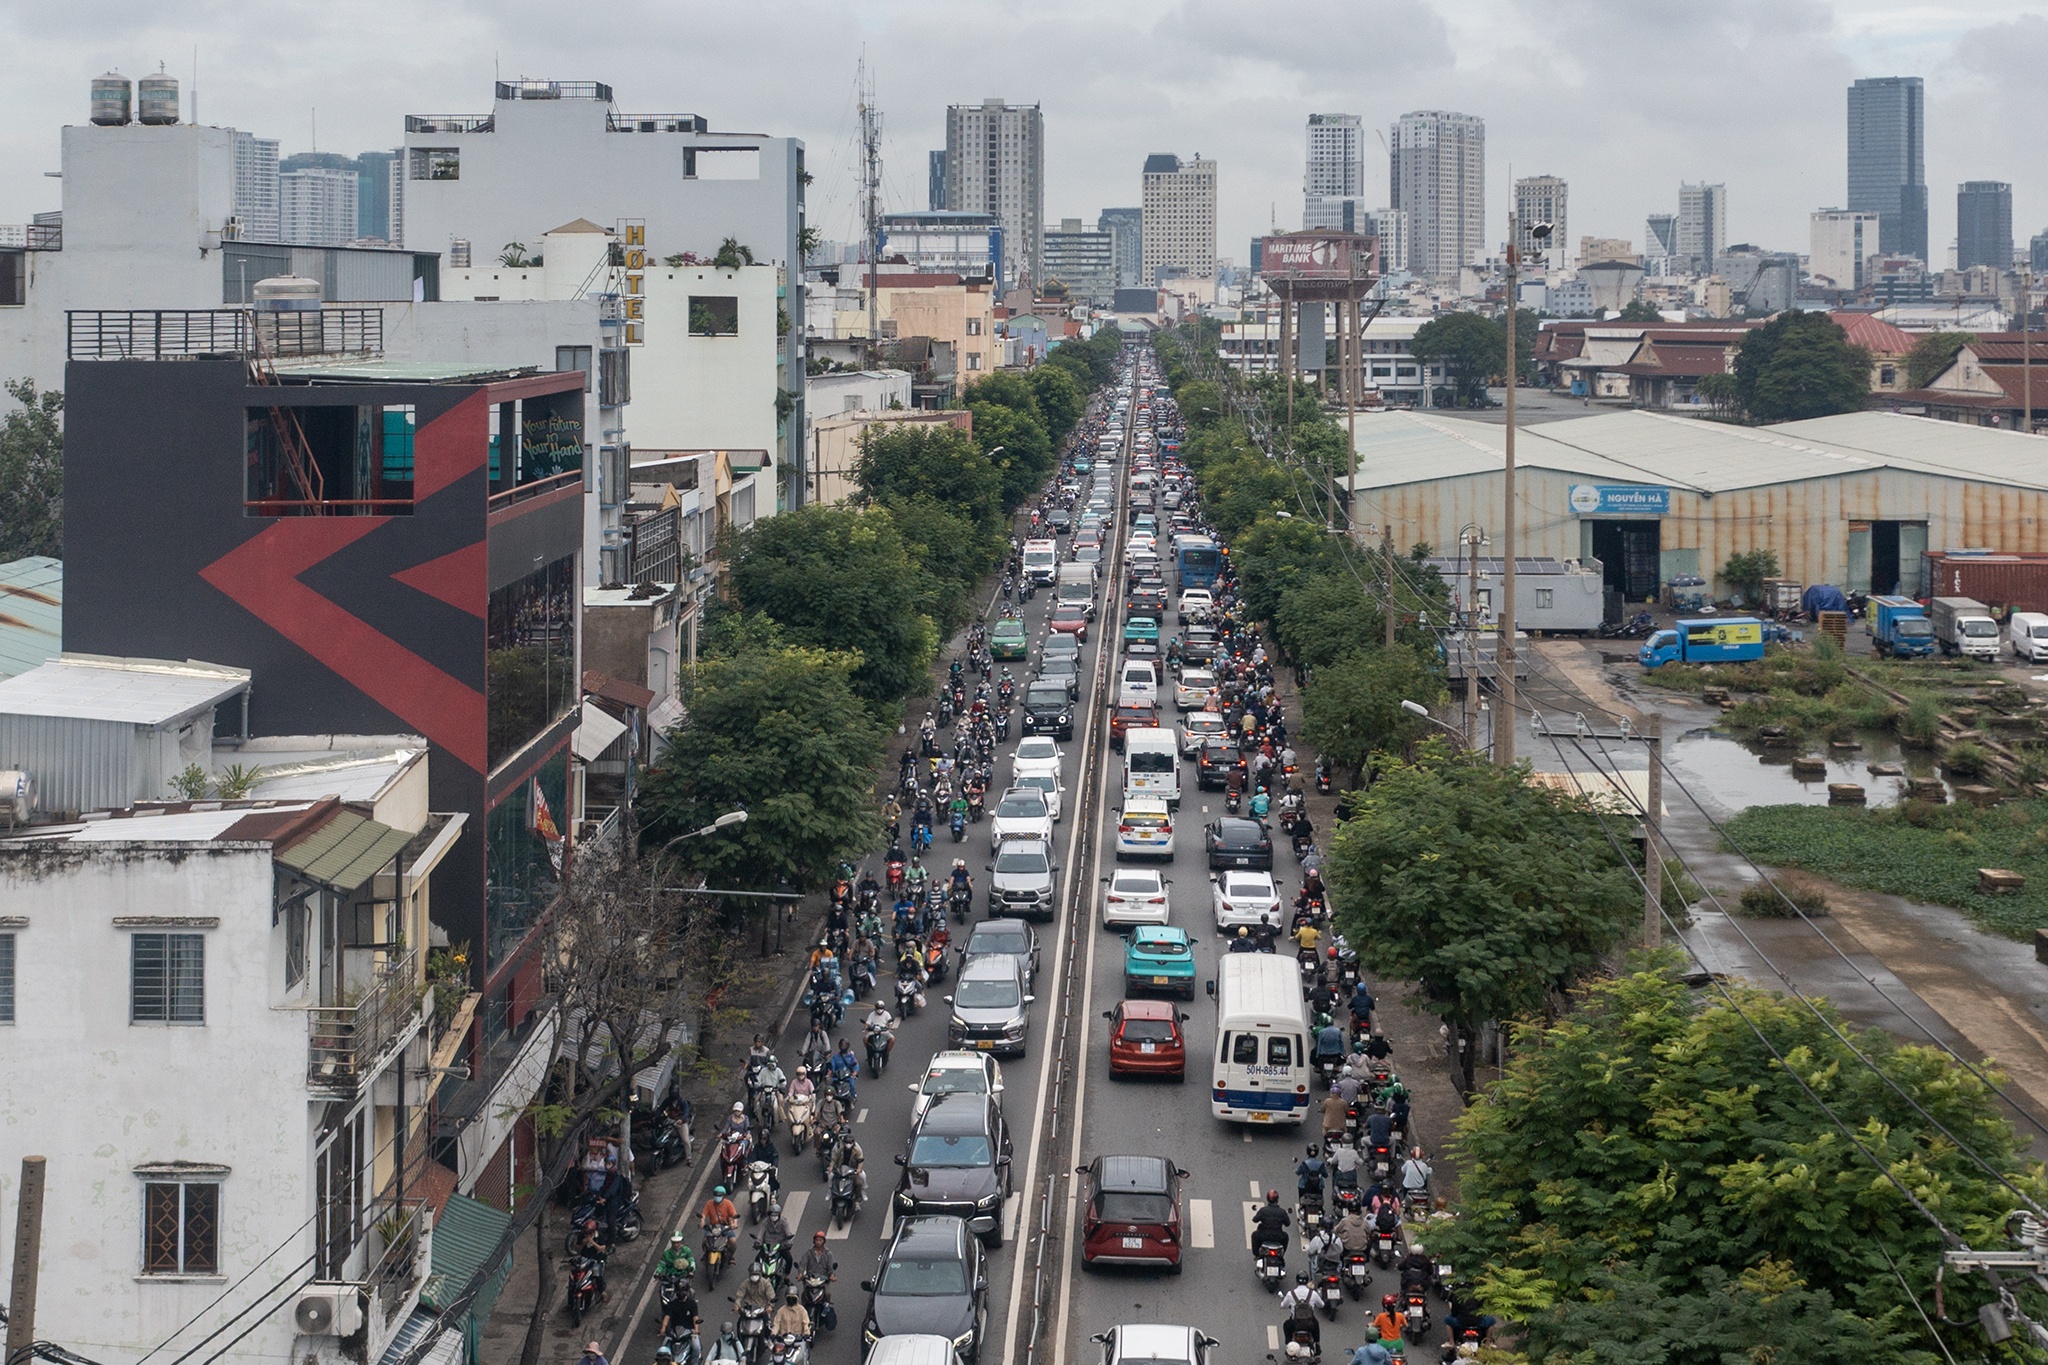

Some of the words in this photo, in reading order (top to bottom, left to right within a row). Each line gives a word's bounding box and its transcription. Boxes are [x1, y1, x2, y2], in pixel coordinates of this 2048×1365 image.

[1268, 243, 1312, 254] MARITIME
[1282, 253, 1311, 263] BANK
[625, 225, 645, 343] HOTEL
[523, 419, 547, 436] Your
[549, 415, 582, 433] Future
[523, 438, 549, 460] Your
[549, 434, 583, 462] Hand
[1648, 493, 1662, 503] HÀ
[1246, 1065, 1289, 1076] 50H-885.44
